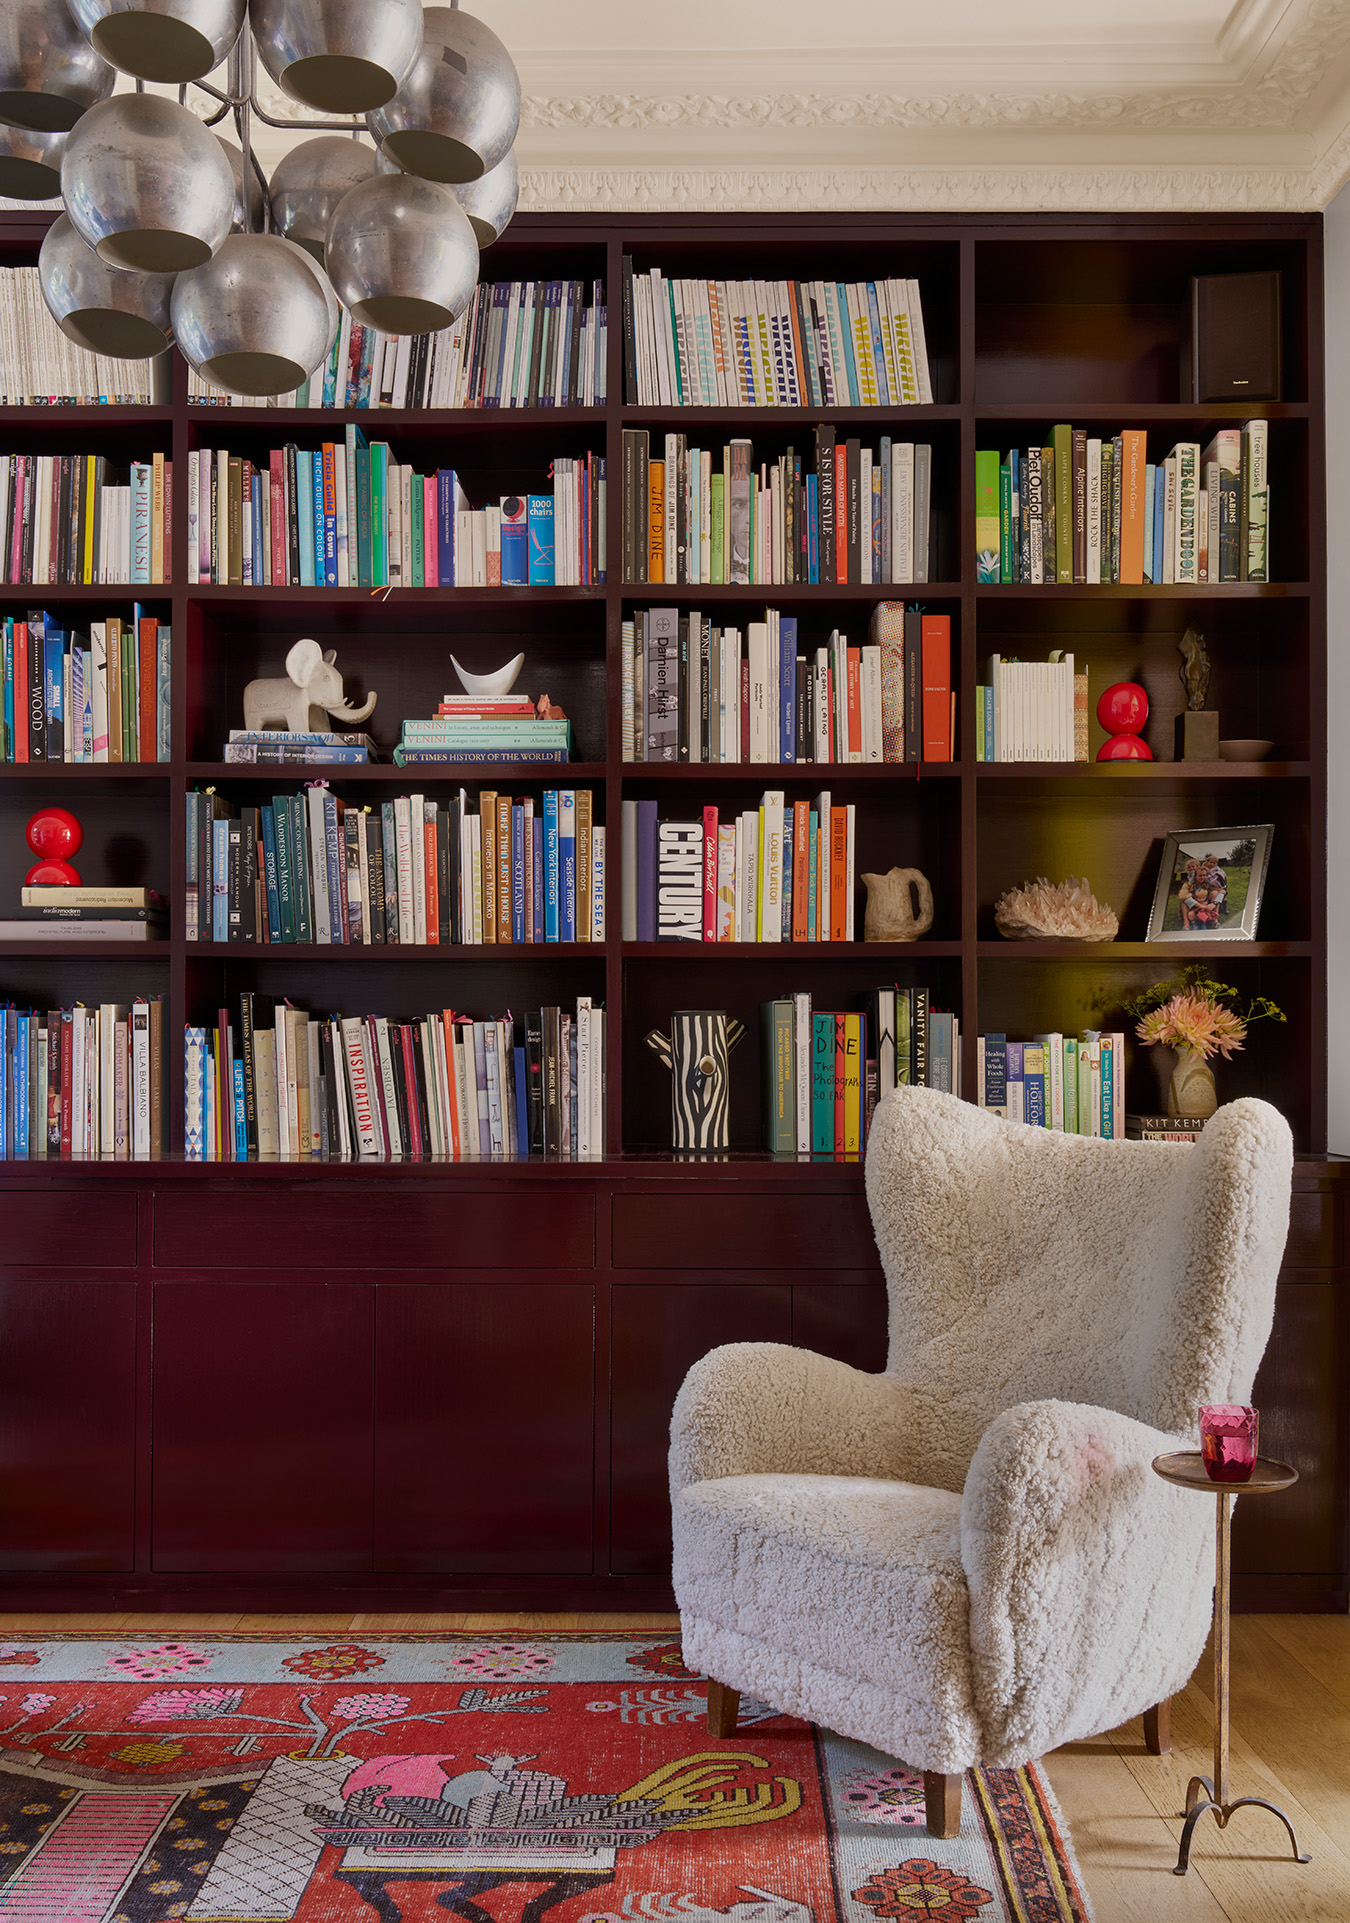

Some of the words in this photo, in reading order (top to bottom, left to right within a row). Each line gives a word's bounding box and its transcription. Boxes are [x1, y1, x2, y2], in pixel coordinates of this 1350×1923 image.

[854, 316, 878, 405] WRIGHT
[894, 312, 916, 401] WRIGHT
[1255, 436, 1263, 455] tree
[822, 459, 832, 469] IS
[1029, 450, 1042, 473] Piet
[1180, 448, 1195, 477] THE
[1254, 457, 1264, 487] houses
[822, 473, 832, 495] FOR
[1076, 467, 1085, 494] Alpine
[652, 486, 662, 514] JIM
[1029, 476, 1042, 521] Oudolf
[1180, 478, 1195, 538] GARDEN
[316, 514, 322, 526] ON
[822, 499, 832, 535] STYLE
[1077, 496, 1085, 532] Interiors
[136, 492, 148, 571] PIRANESI
[652, 525, 662, 560] DINE
[1180, 539, 1194, 579] BOOK
[143, 624, 154, 655] Pierre
[783, 630, 793, 664] William
[658, 637, 668, 685] Damien
[143, 655, 154, 716] Yovanovitch
[783, 666, 793, 686] Scott
[884, 640, 902, 728] KOONS
[32, 686, 42, 730] WOOD
[658, 690, 668, 719] Hirst
[401, 754, 418, 764] THE
[420, 753, 447, 763] TIMES
[449, 753, 486, 763] HISTORY
[488, 753, 498, 763] OF
[500, 753, 519, 763] THE
[520, 752, 553, 762] WORLD
[326, 802, 336, 821] KIT
[834, 818, 843, 834] DAVID
[277, 814, 287, 867] WADDESDON
[327, 826, 337, 858] KEMP
[399, 824, 408, 842] The
[580, 827, 588, 854] Indian
[706, 836, 715, 858] Celia
[770, 832, 780, 862] Louis
[784, 825, 793, 844] Art
[368, 854, 375, 866] OF
[834, 836, 843, 861] HOCKNEY
[266, 852, 276, 890] STORAGE
[399, 844, 410, 896] Well-Lived
[580, 855, 588, 891] Interiors
[595, 862, 603, 875] BY
[659, 823, 703, 941] CENTURY
[706, 858, 715, 894] Birtwell
[281, 870, 289, 902] MANOR
[770, 866, 780, 905] Vuitton
[402, 900, 411, 918] Life
[816, 1020, 844, 1034] JIM
[917, 994, 925, 1036] VANITY
[116, 1030, 125, 1086] COACHMAKER
[816, 1036, 857, 1055] DINE
[917, 1043, 925, 1068] FAIR
[235, 1069, 243, 1092] LIFE'S
[246, 1065, 251, 1075] OF
[815, 1062, 834, 1071] The
[917, 1074, 925, 1088] PO
[348, 1043, 372, 1132] INSPIRATION
[382, 1058, 395, 1109] JACOBSEN
[813, 1091, 826, 1100] So
[827, 1091, 844, 1100] FAR
[868, 1073, 876, 1091] TIN
[236, 1100, 244, 1121] PITCH
[1030, 1082, 1038, 1126] HOLFOR
[1146, 1119, 1168, 1127] KIT
[1174, 1119, 1208, 1127] KEMP
